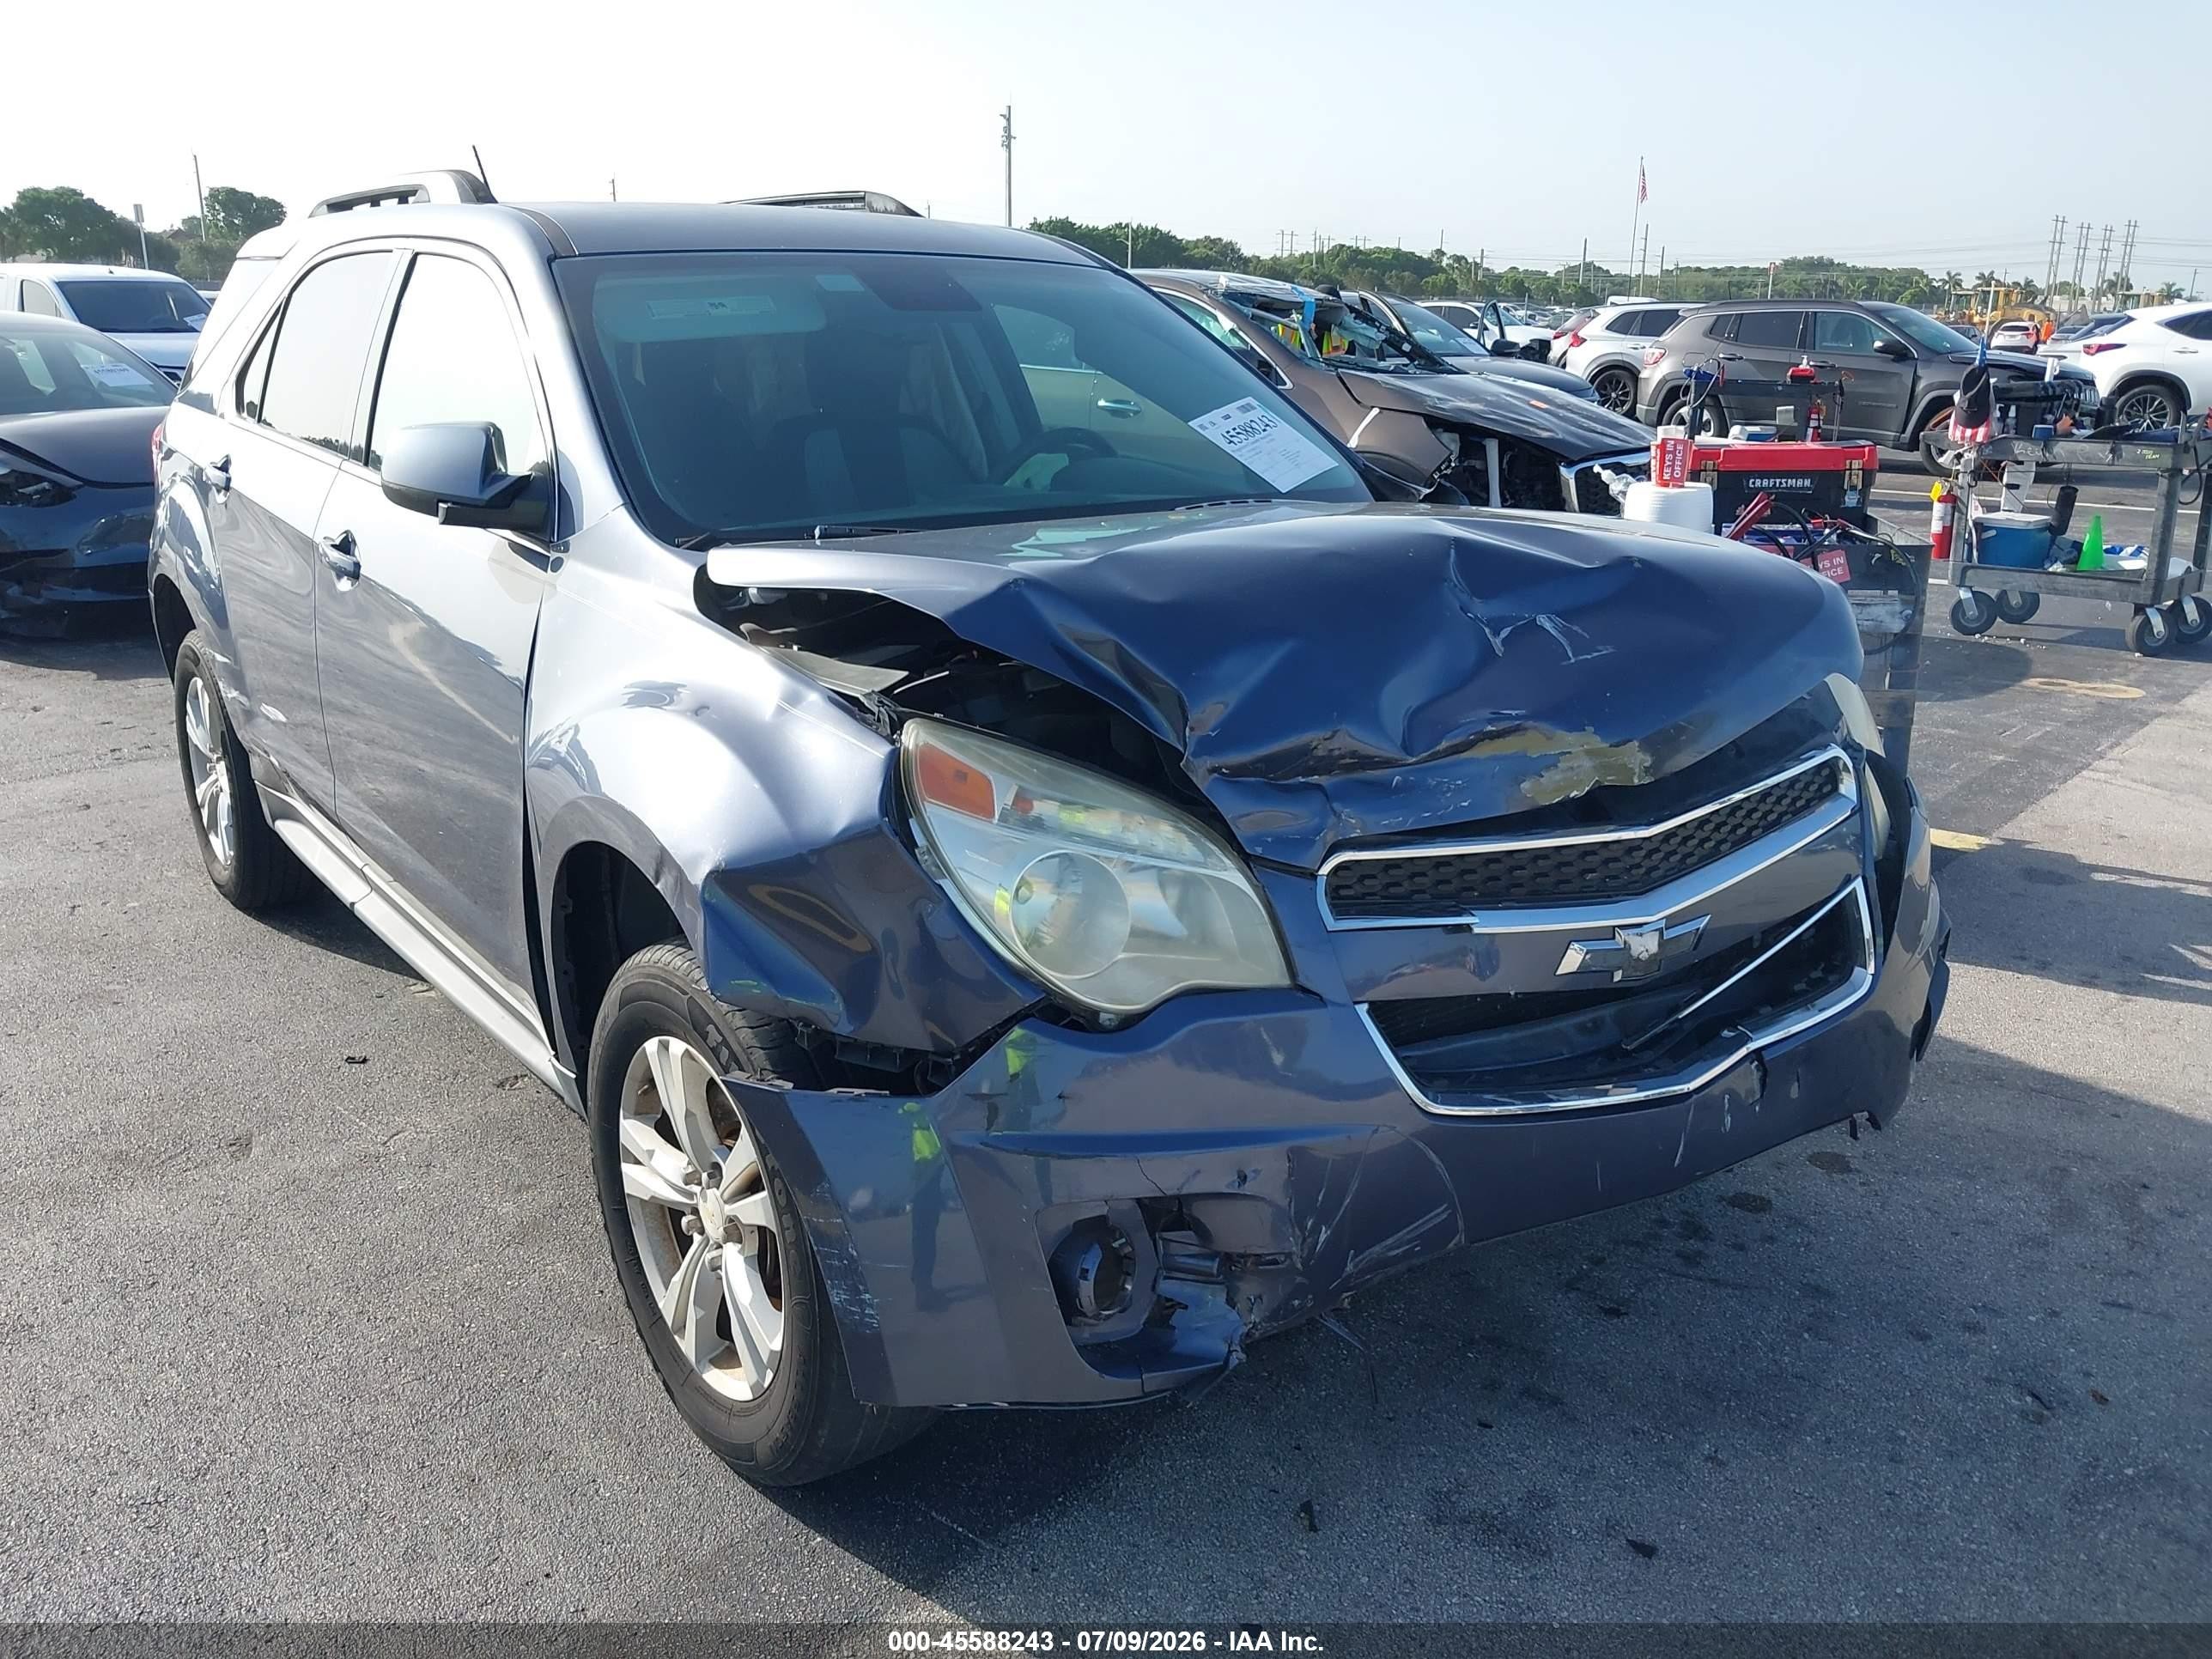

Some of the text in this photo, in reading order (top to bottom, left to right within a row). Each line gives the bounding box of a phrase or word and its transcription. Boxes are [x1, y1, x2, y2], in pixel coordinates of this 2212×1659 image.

[1220, 414, 1279, 447] 45588243
[1662, 440, 1674, 480] KEYS IN
[1673, 443, 1684, 478] OFFICE
[1748, 478, 1812, 489] CRAFTSMAN
[1818, 556, 1844, 569] YS IN
[1821, 567, 1844, 578] FICE
